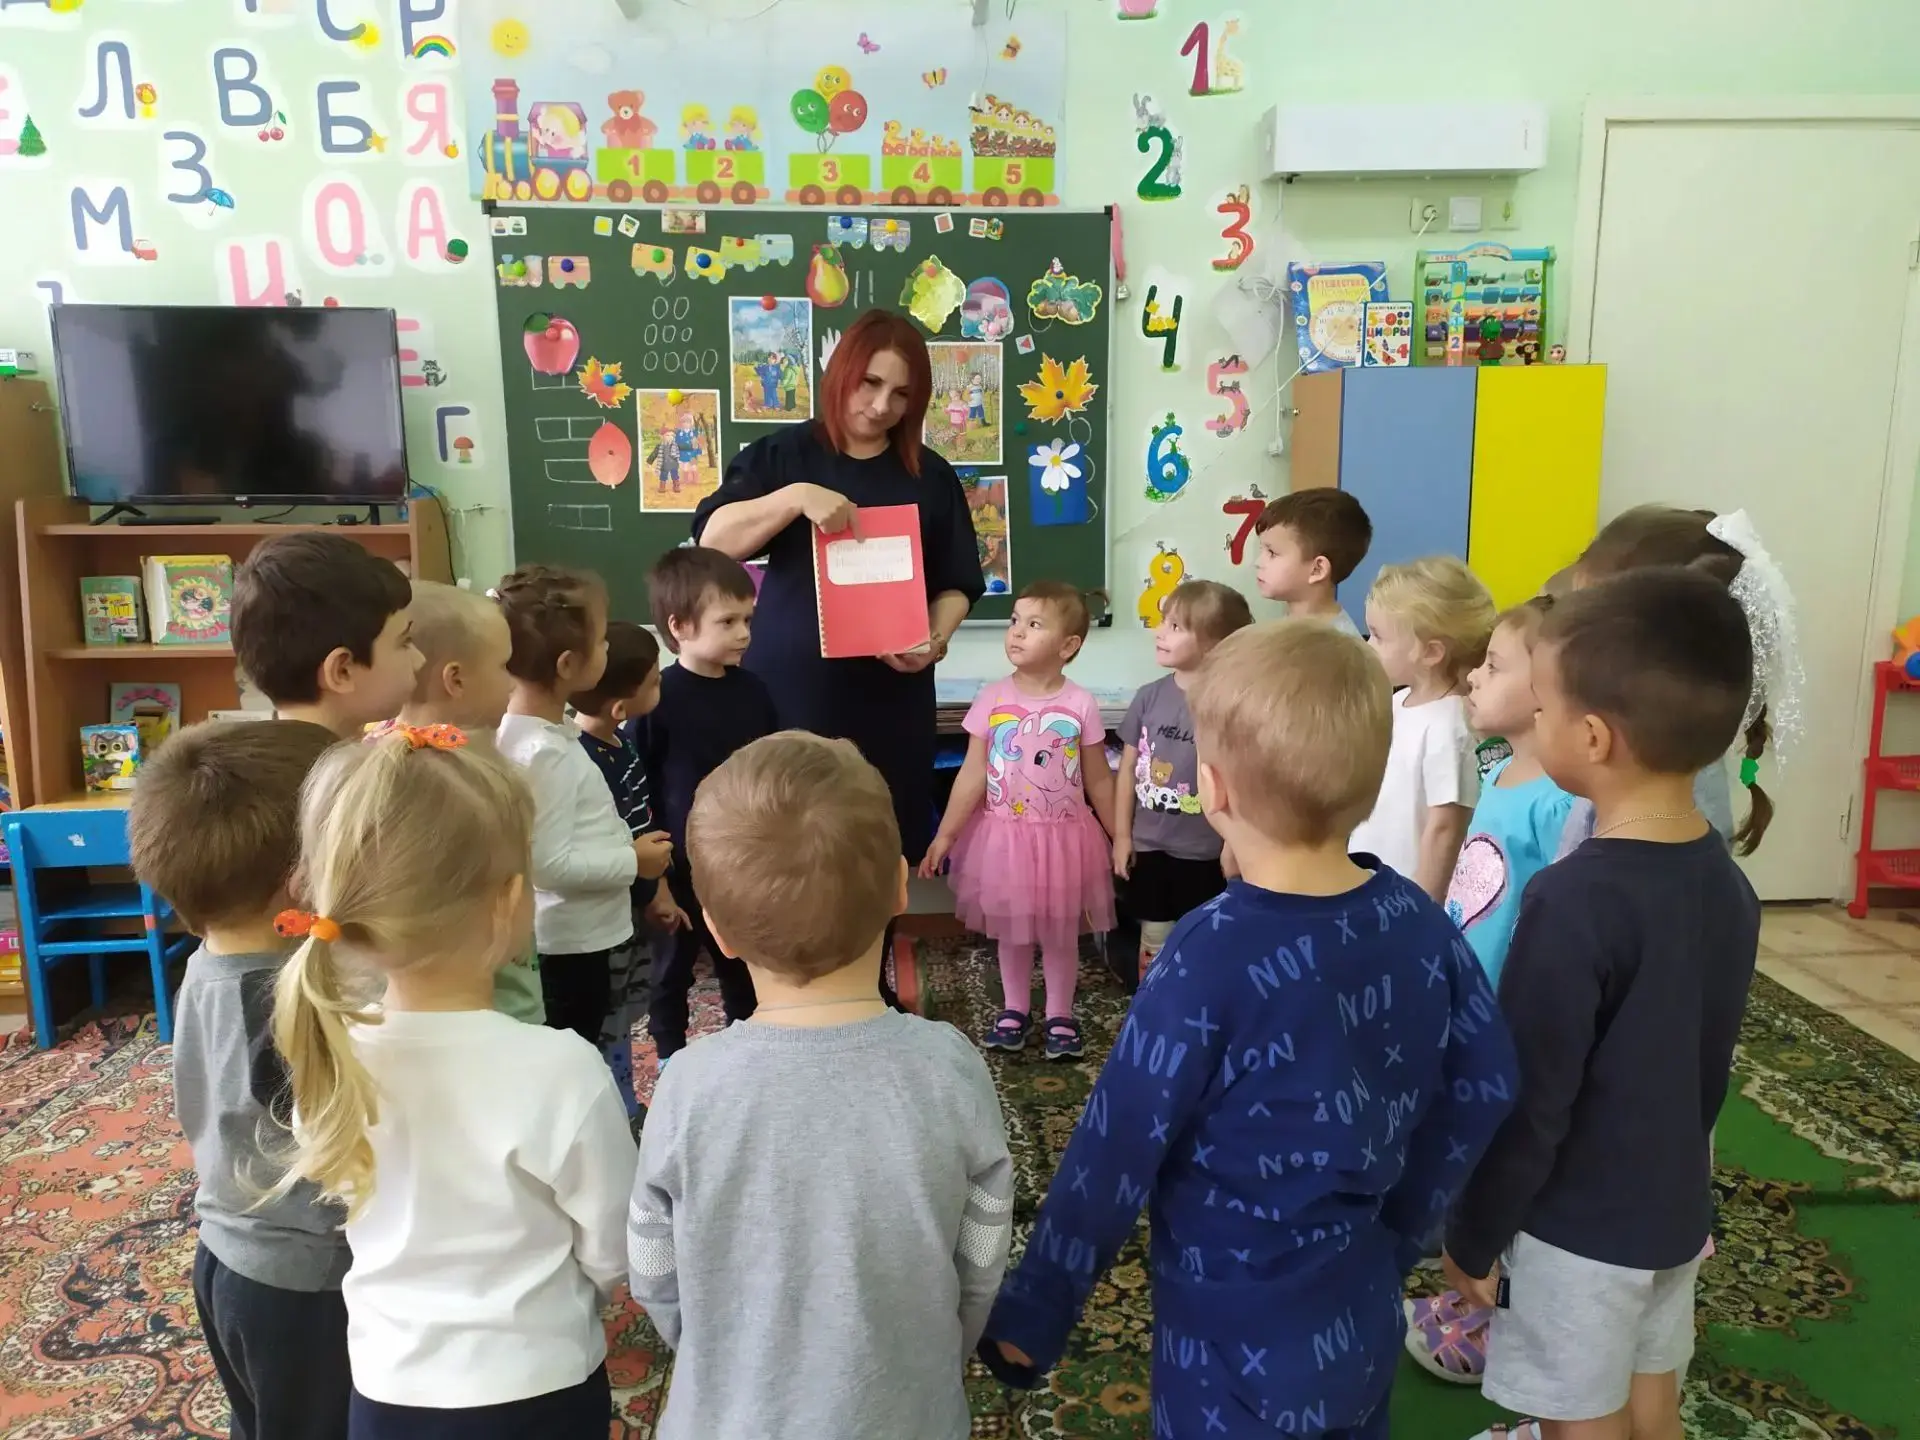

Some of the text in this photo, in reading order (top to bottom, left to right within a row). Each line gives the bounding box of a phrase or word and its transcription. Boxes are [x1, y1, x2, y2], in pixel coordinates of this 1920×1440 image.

[79, 41, 135, 119] Л
[213, 48, 272, 126] В
[1180, 22, 1209, 94] 1
[317, 81, 374, 153] Б
[406, 83, 450, 155] Я
[628, 155, 640, 176] 1
[717, 157, 734, 178] 2
[822, 161, 838, 182] 3
[913, 163, 931, 183] 4
[1006, 164, 1022, 184] 5
[1137, 126, 1182, 200] 2
[71, 186, 134, 250] М
[407, 186, 447, 259] А
[1212, 203, 1255, 268] 3
[1143, 285, 1182, 368] 4
[1396, 343, 1409, 359] 4
[1205, 361, 1249, 431] 5
[436, 406, 471, 462] Г
[1147, 425, 1190, 493] 6
[1223, 500, 1266, 565] 7
[1138, 552, 1184, 628] 8
[1157, 723, 1195, 745] HELL
[1248, 934, 1322, 1000] NO!
[1337, 974, 1392, 1036] NO!
[1118, 1013, 1188, 1098] NO!
